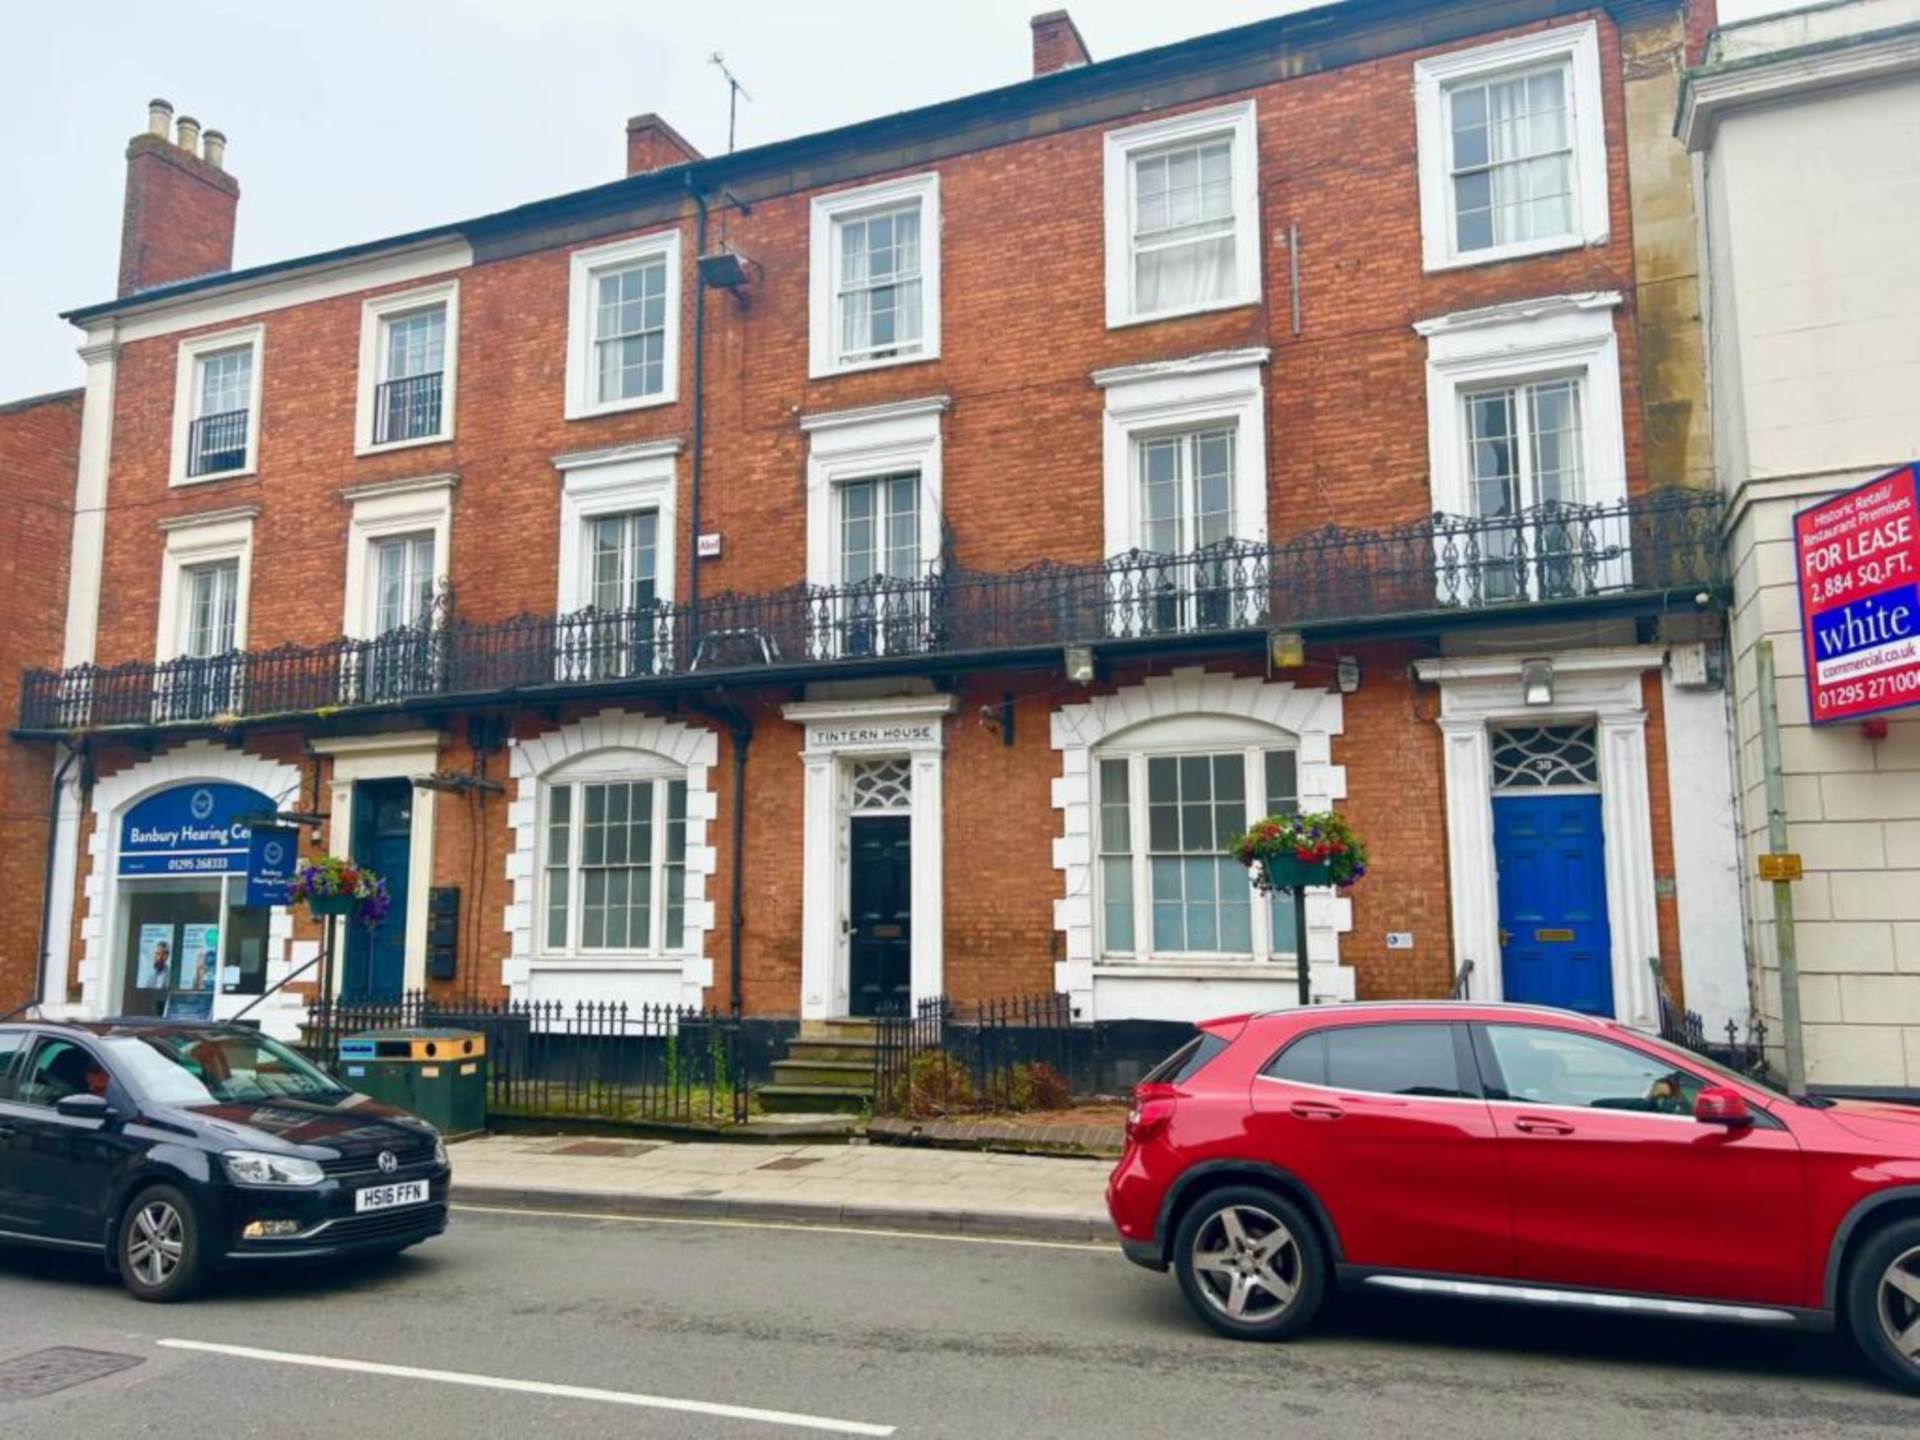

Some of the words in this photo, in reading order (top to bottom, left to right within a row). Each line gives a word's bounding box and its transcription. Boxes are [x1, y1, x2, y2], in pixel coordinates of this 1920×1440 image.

[1803, 516, 1857, 546] Restaurant
[1858, 496, 1911, 525] Premises
[1814, 503, 1855, 528] Historic
[1805, 543, 1843, 577] FOR
[1845, 516, 1912, 561] LEASE
[1811, 571, 1852, 603] 2,884
[1857, 551, 1913, 586] SQ.FT.
[1819, 600, 1911, 655] white
[1823, 642, 1916, 678] commercial.co.uk
[1819, 683, 1864, 709] 01295
[1867, 669, 1920, 699] 27100
[816, 730, 879, 742] TINTERN
[883, 727, 931, 738] HOUSE
[130, 827, 179, 848] Banbury
[181, 825, 228, 846] Hearing
[168, 858, 194, 870] 01295
[364, 1187, 394, 1207] HS16
[396, 1184, 422, 1203] FFN
